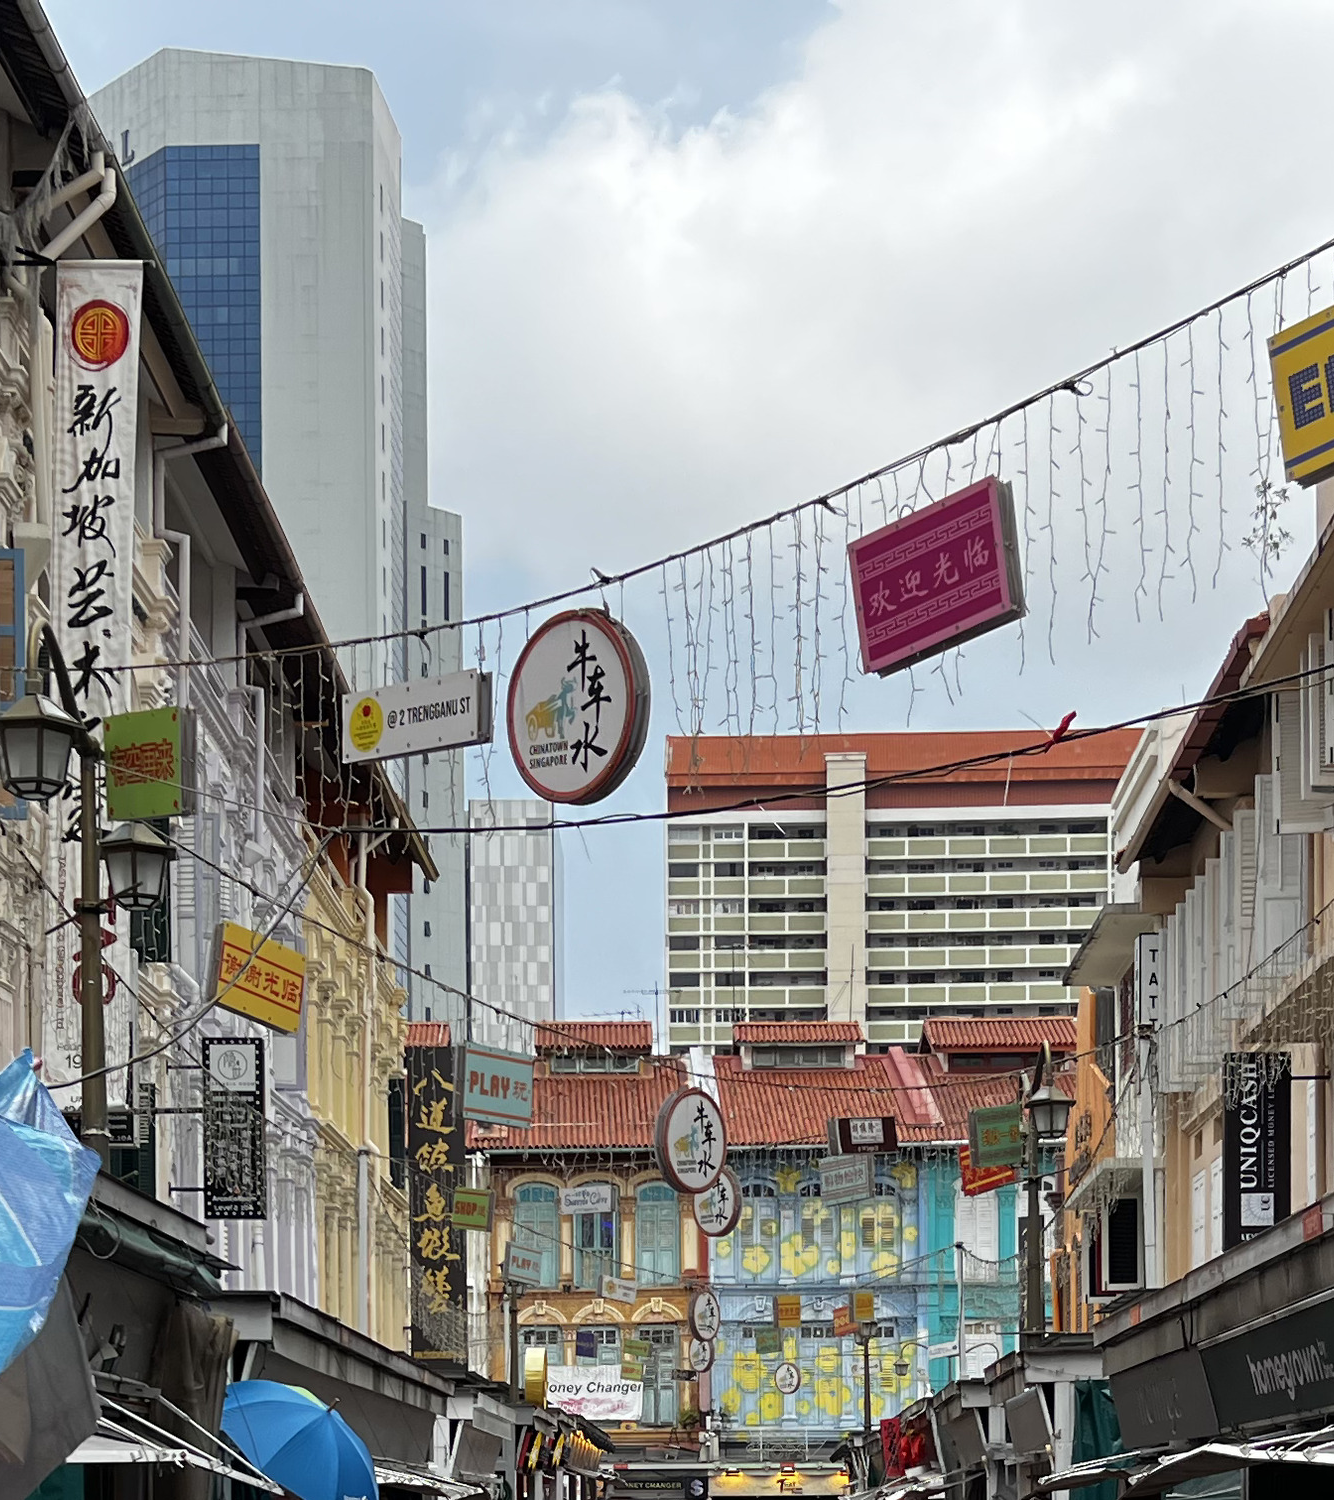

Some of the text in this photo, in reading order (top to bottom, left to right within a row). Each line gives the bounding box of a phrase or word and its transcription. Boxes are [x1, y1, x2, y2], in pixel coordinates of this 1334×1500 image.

[868, 535, 991, 618] 欢迎光临
[387, 696, 471, 729] @ 2 TRENGGANU ST
[567, 629, 612, 773] 牛车水
[111, 738, 175, 787] 有空再来
[529, 740, 568, 756] CHINATOWN
[529, 753, 568, 770] SINGAPORE
[225, 952, 300, 1004] 谢谢光临
[469, 1070, 511, 1100] PLAY
[512, 1080, 529, 1102] 玩
[1240, 1062, 1261, 1190] UNIQCASH
[1267, 1102, 1275, 1138] MONEY
[694, 1099, 717, 1178] 牛车水
[1267, 1145, 1275, 1189] LICENSED
[455, 1201, 478, 1216] SHOP
[511, 1255, 532, 1271] PLAY
[548, 1381, 643, 1396] oney Changer
[1245, 1342, 1325, 1401] homegrown
[645, 1481, 682, 1490] CHANGER
